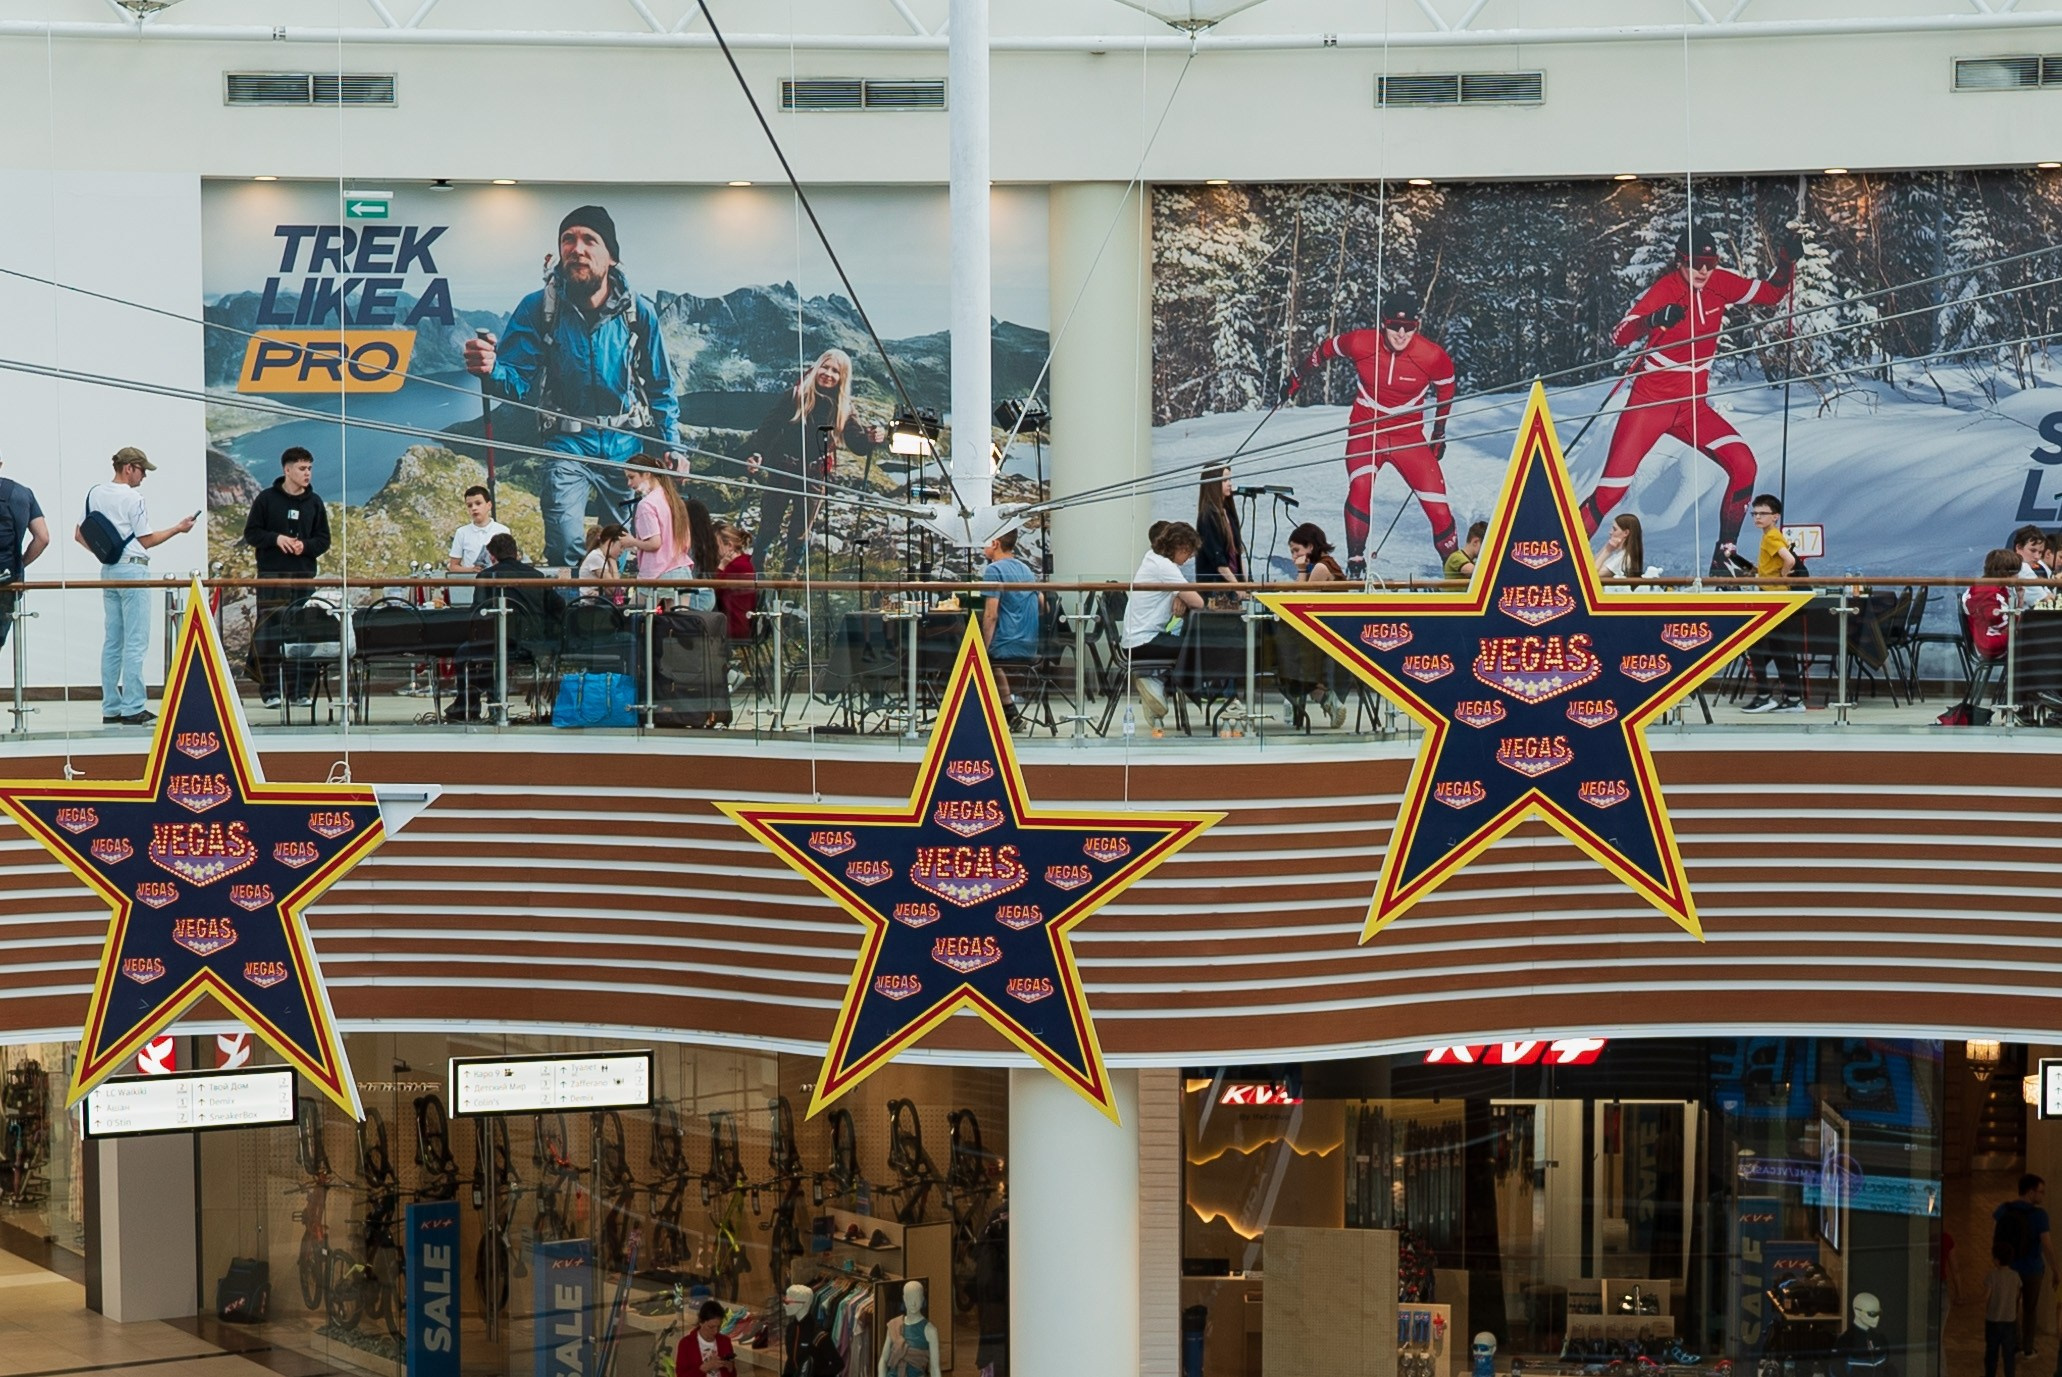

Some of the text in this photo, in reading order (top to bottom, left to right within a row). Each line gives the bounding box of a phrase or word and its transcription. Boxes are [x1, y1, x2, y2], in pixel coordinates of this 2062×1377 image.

[274, 225, 449, 274] TREK
[256, 277, 455, 326] LIKE A
[250, 341, 400, 382] PRO
[2015, 469, 2062, 522] L
[1512, 540, 1559, 556] VEGAS
[1501, 584, 1571, 607] VEGAS
[1362, 622, 1409, 638] VEGAS
[1662, 622, 1710, 638] VEGAS
[1479, 634, 1593, 672] VEGAS
[1403, 654, 1450, 670] VEGAS
[1621, 654, 1668, 670] VEGAS
[1456, 700, 1503, 716] VEGAS
[1568, 700, 1615, 716] VEGAS
[177, 732, 217, 748] VEGAS
[1500, 735, 1568, 759] VEGAS
[949, 760, 991, 774] VEGAS
[169, 774, 229, 797] VEGAS
[1436, 780, 1483, 796] VEGAS
[1580, 780, 1626, 796] VEGAS
[57, 808, 96, 824] VEGAS
[937, 800, 1000, 820] VEGAS
[310, 813, 352, 828] VEGAS
[92, 838, 131, 854] VEGAS
[153, 821, 251, 857] VEGAS
[810, 831, 853, 846] VEGAS
[1086, 837, 1128, 852] VEGAS
[275, 842, 317, 858] VEGAS
[848, 861, 890, 876] VEGAS
[917, 846, 1023, 879] VEGAS
[1047, 865, 1089, 879] VEGAS
[137, 882, 177, 898] VEGAS
[231, 884, 272, 900] VEGAS
[895, 903, 938, 917] VEGAS
[998, 905, 1040, 919] VEGAS
[174, 917, 233, 940] VEGAS
[934, 936, 998, 957] VEGAS
[124, 958, 163, 973] VEGAS
[245, 961, 286, 977] VEGAS
[876, 975, 918, 989] VEGAS
[1008, 978, 1051, 992] VEGAS
[231, 1082, 249, 1091] Дом
[420, 1218, 455, 1229] KV+
[1739, 1213, 1776, 1223] KV+
[552, 1257, 585, 1269] KV+
[423, 1243, 452, 1353] SALE
[554, 1284, 583, 1377] ALE
